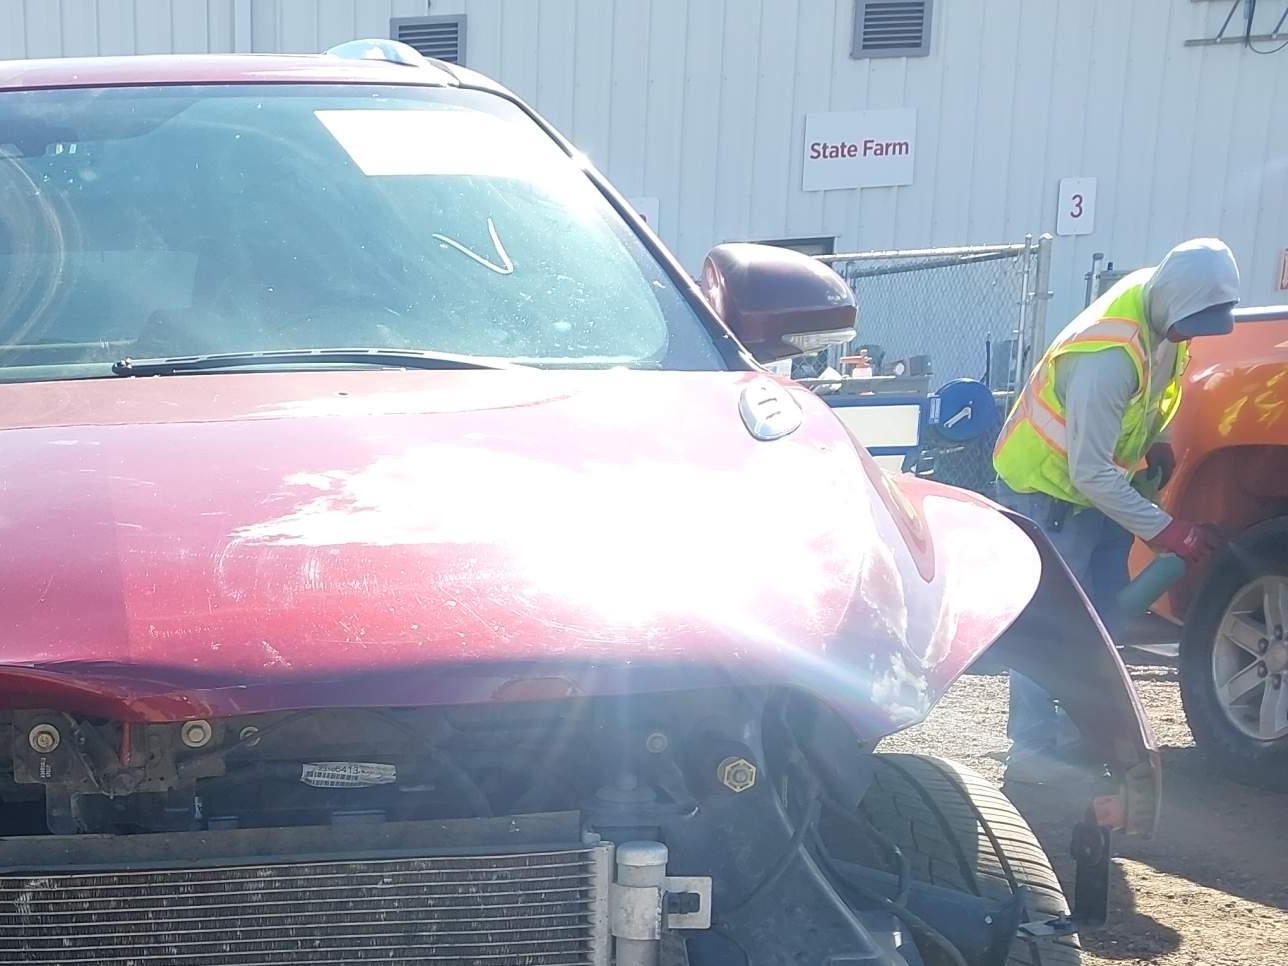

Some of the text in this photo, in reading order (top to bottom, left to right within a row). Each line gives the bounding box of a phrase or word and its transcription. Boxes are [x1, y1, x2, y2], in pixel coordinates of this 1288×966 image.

[810, 139, 909, 160] State Farm
[1070, 194, 1083, 218] 3
